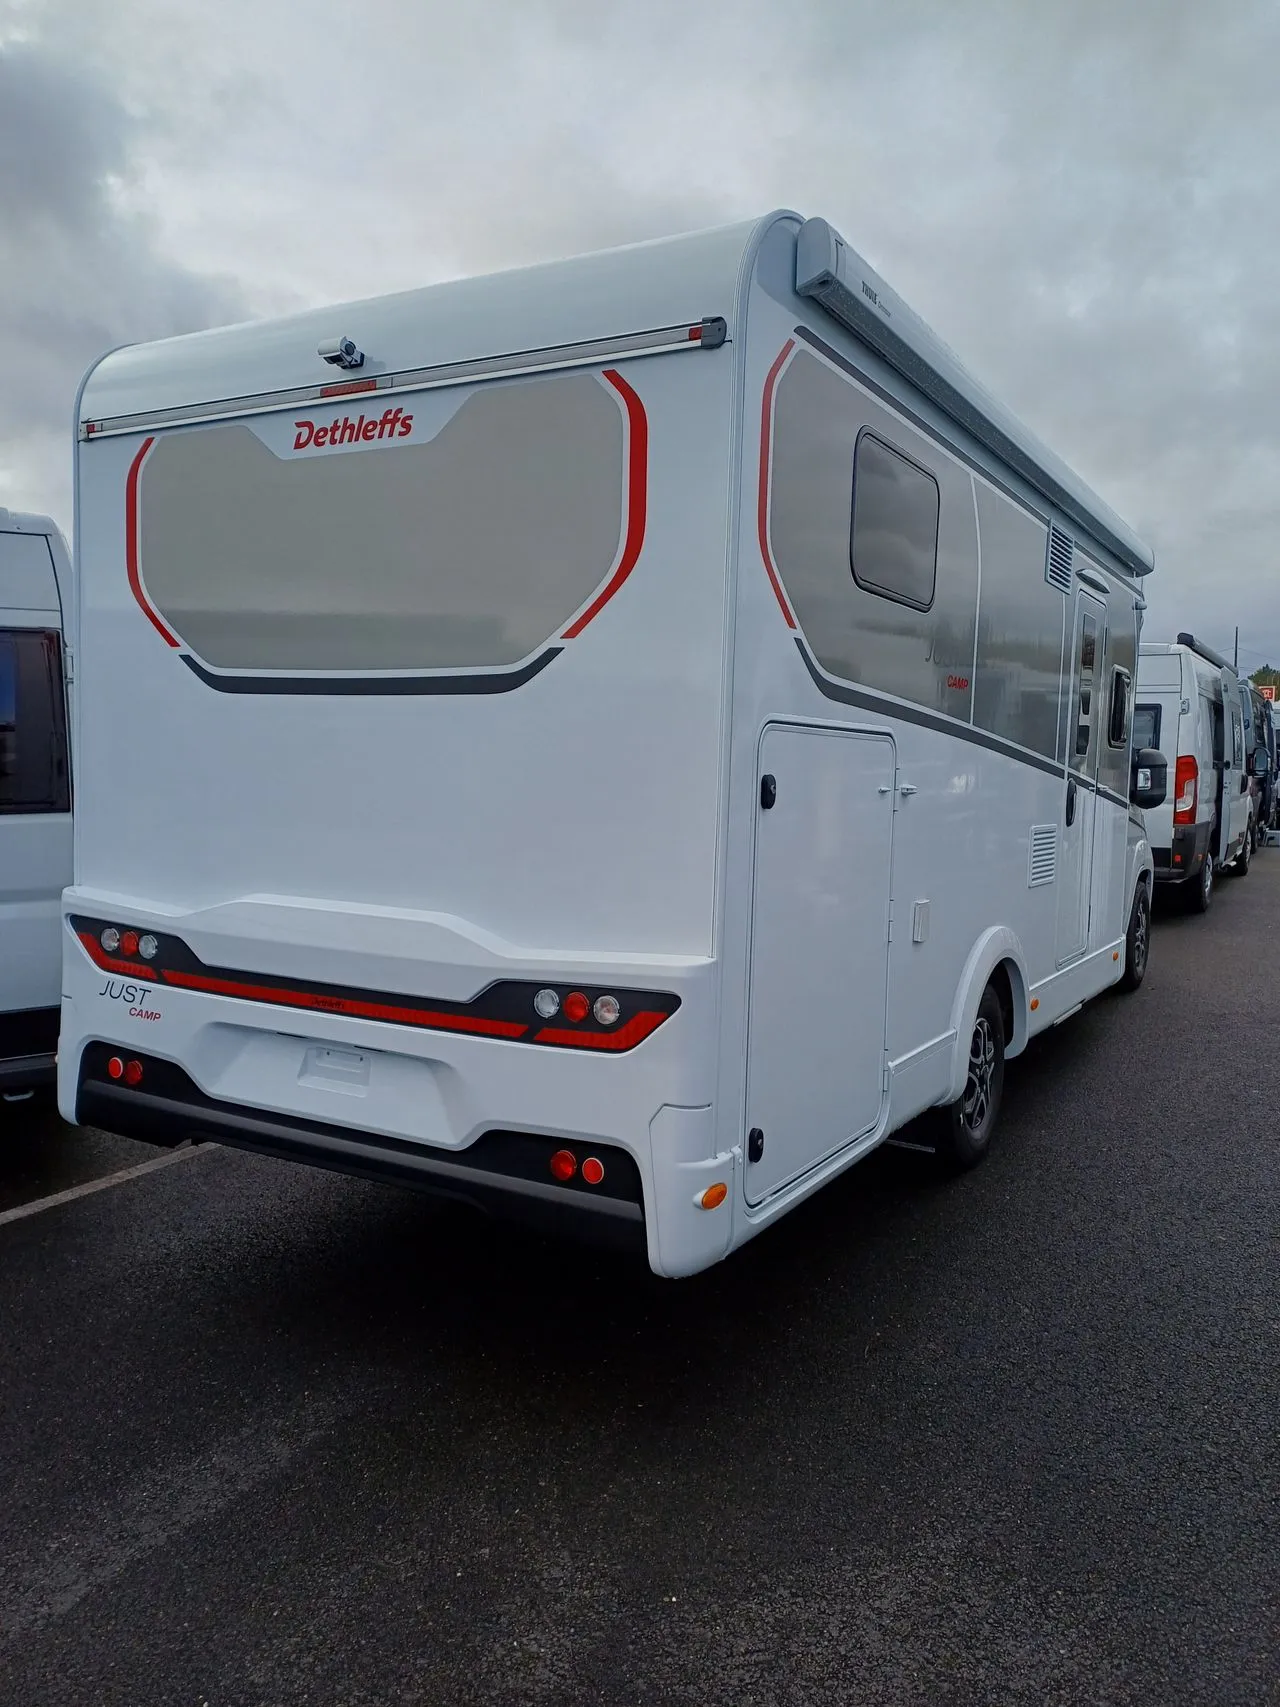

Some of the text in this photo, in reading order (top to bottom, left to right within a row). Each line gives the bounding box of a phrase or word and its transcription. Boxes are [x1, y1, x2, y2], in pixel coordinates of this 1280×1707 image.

[861, 279, 877, 305] THULE
[293, 407, 413, 450] Dethleffs
[947, 674, 969, 690] CAMP
[98, 980, 152, 1006] JUST
[129, 1007, 162, 1021] CAMP
